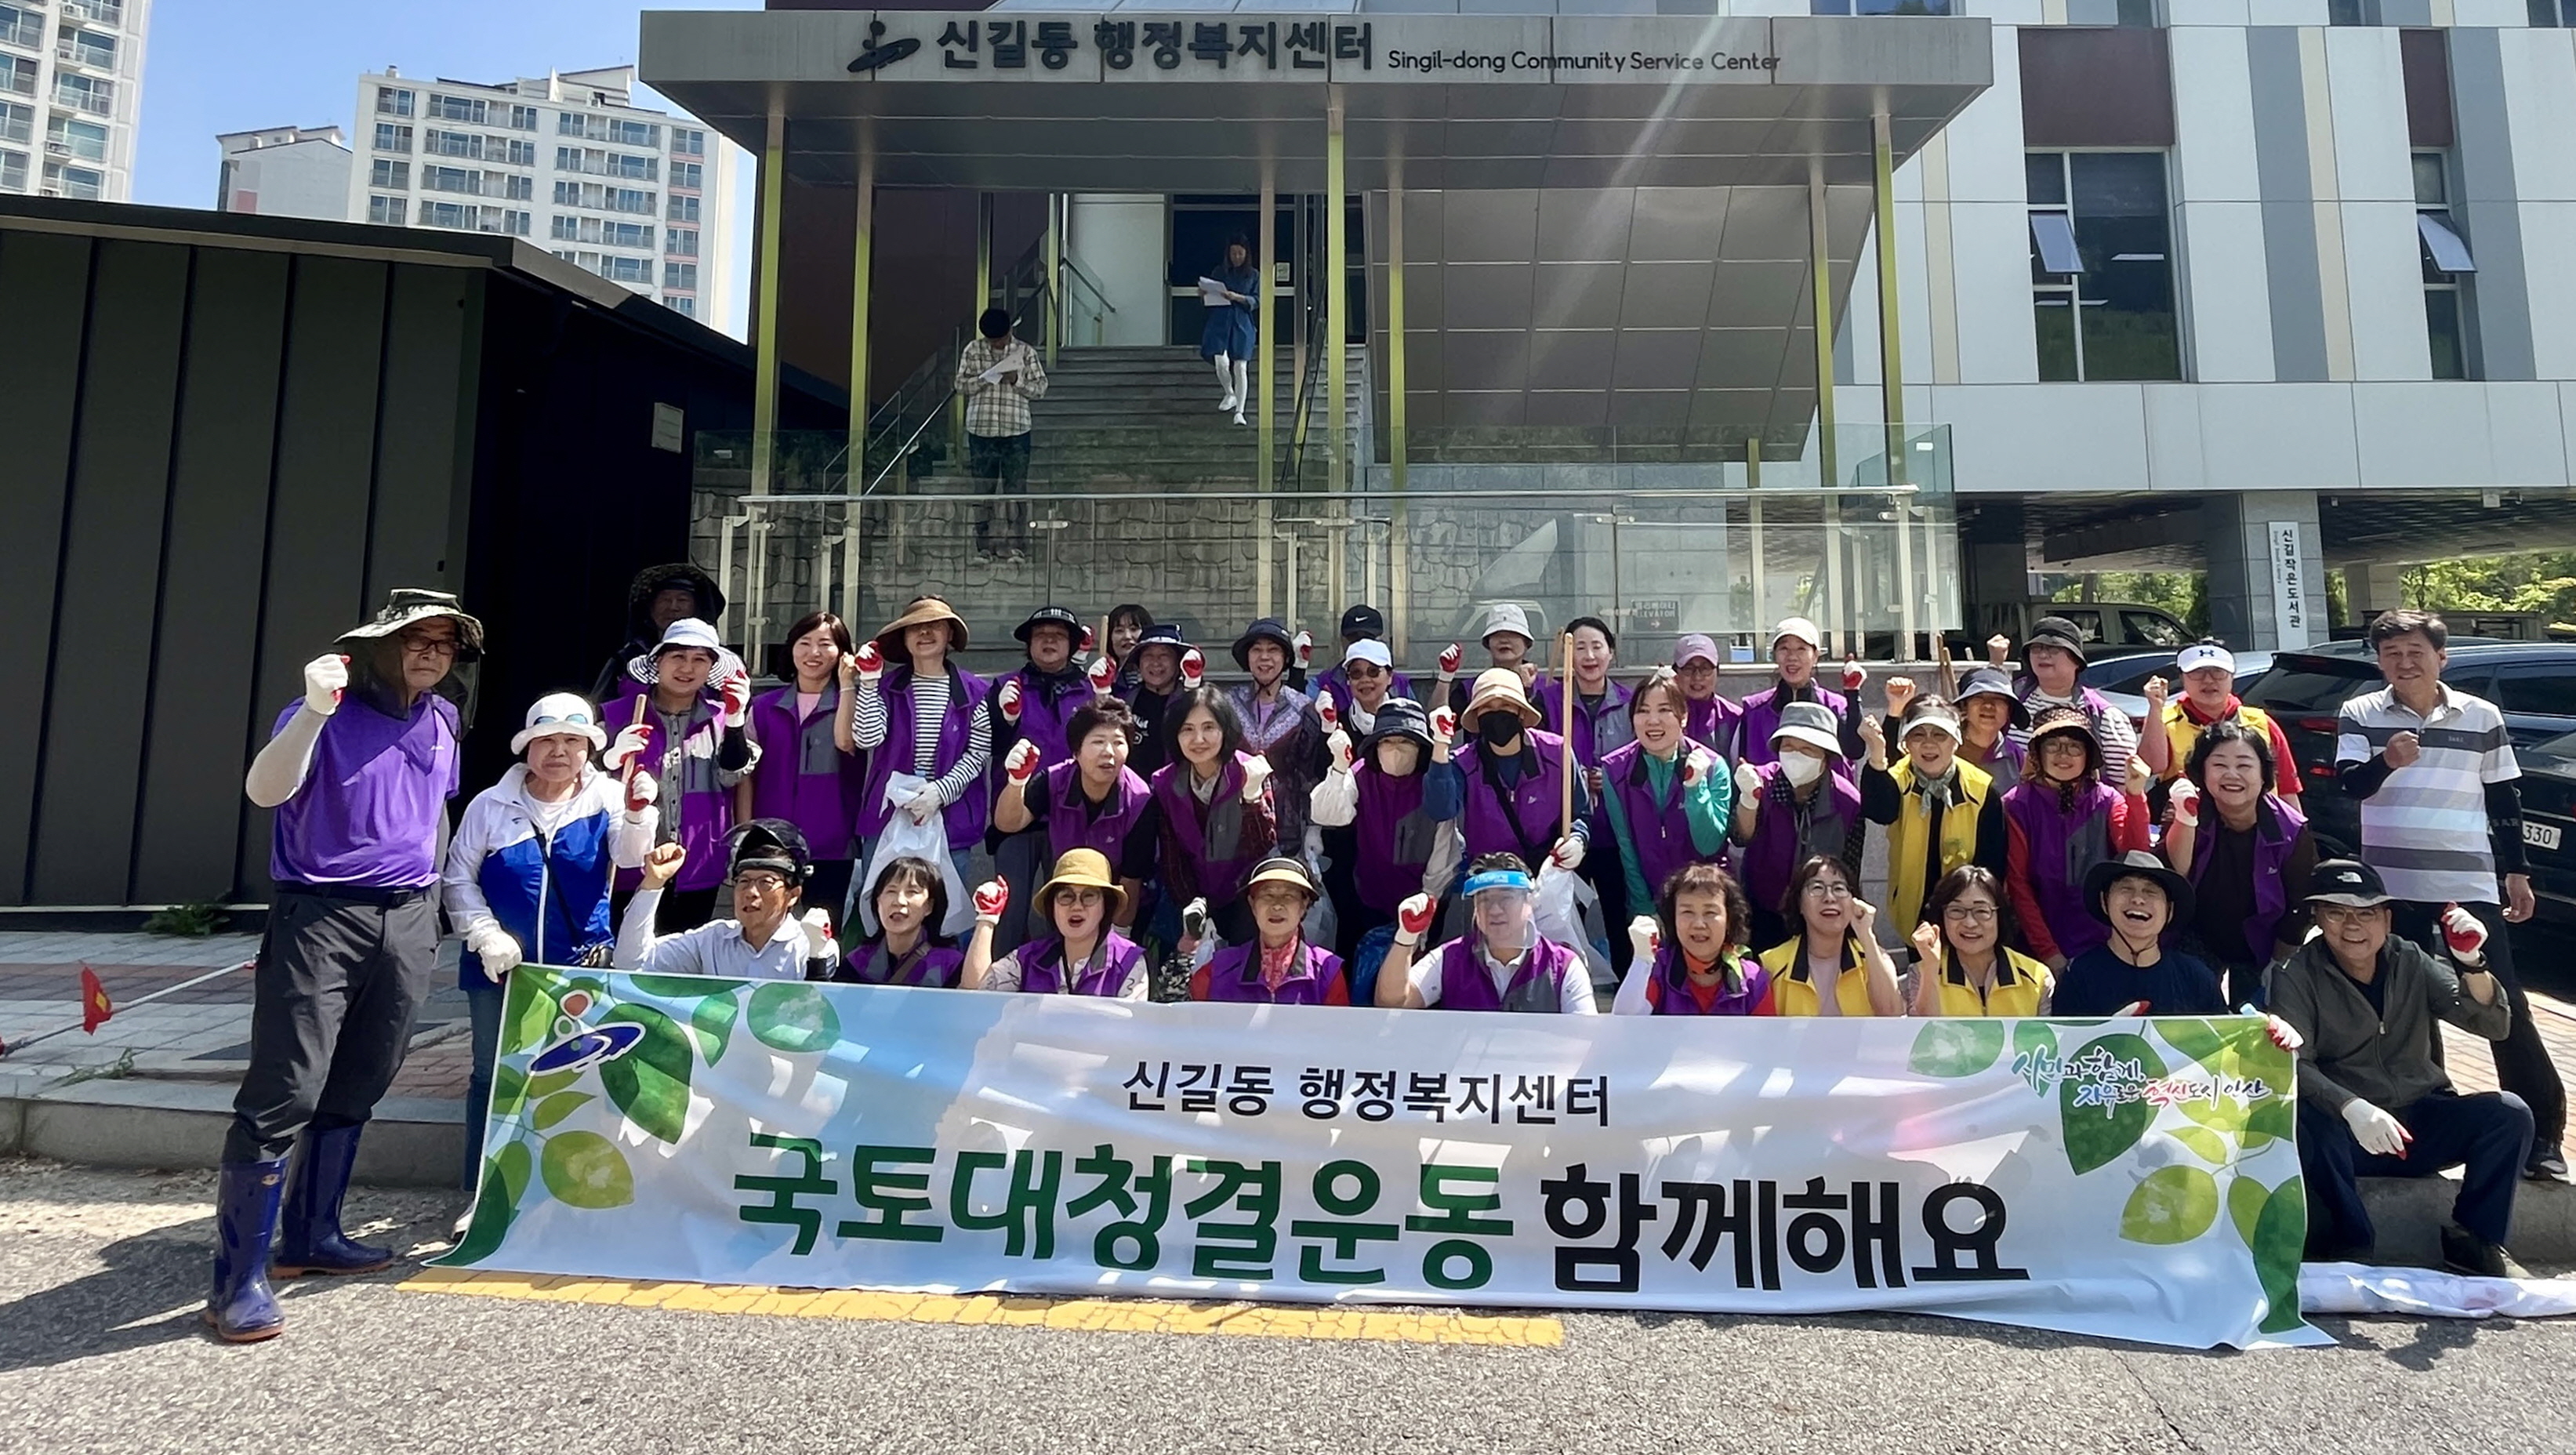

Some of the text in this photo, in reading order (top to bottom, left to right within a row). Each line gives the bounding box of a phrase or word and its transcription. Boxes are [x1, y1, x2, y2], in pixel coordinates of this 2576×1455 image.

[937, 20, 1372, 70] 신길동 행정복지센터
[1388, 50, 1781, 73] Singil-dong Community Service Center
[2282, 528, 2301, 628] 신길작은도서관
[2013, 1046, 2084, 1090] 시민과
[1123, 1060, 1609, 1127] 신길동 행정복지센터
[2076, 1076, 2269, 1118] 자유로운 혁신도시 안산
[734, 1133, 2030, 1292] 국토대청결운동 함께해요
